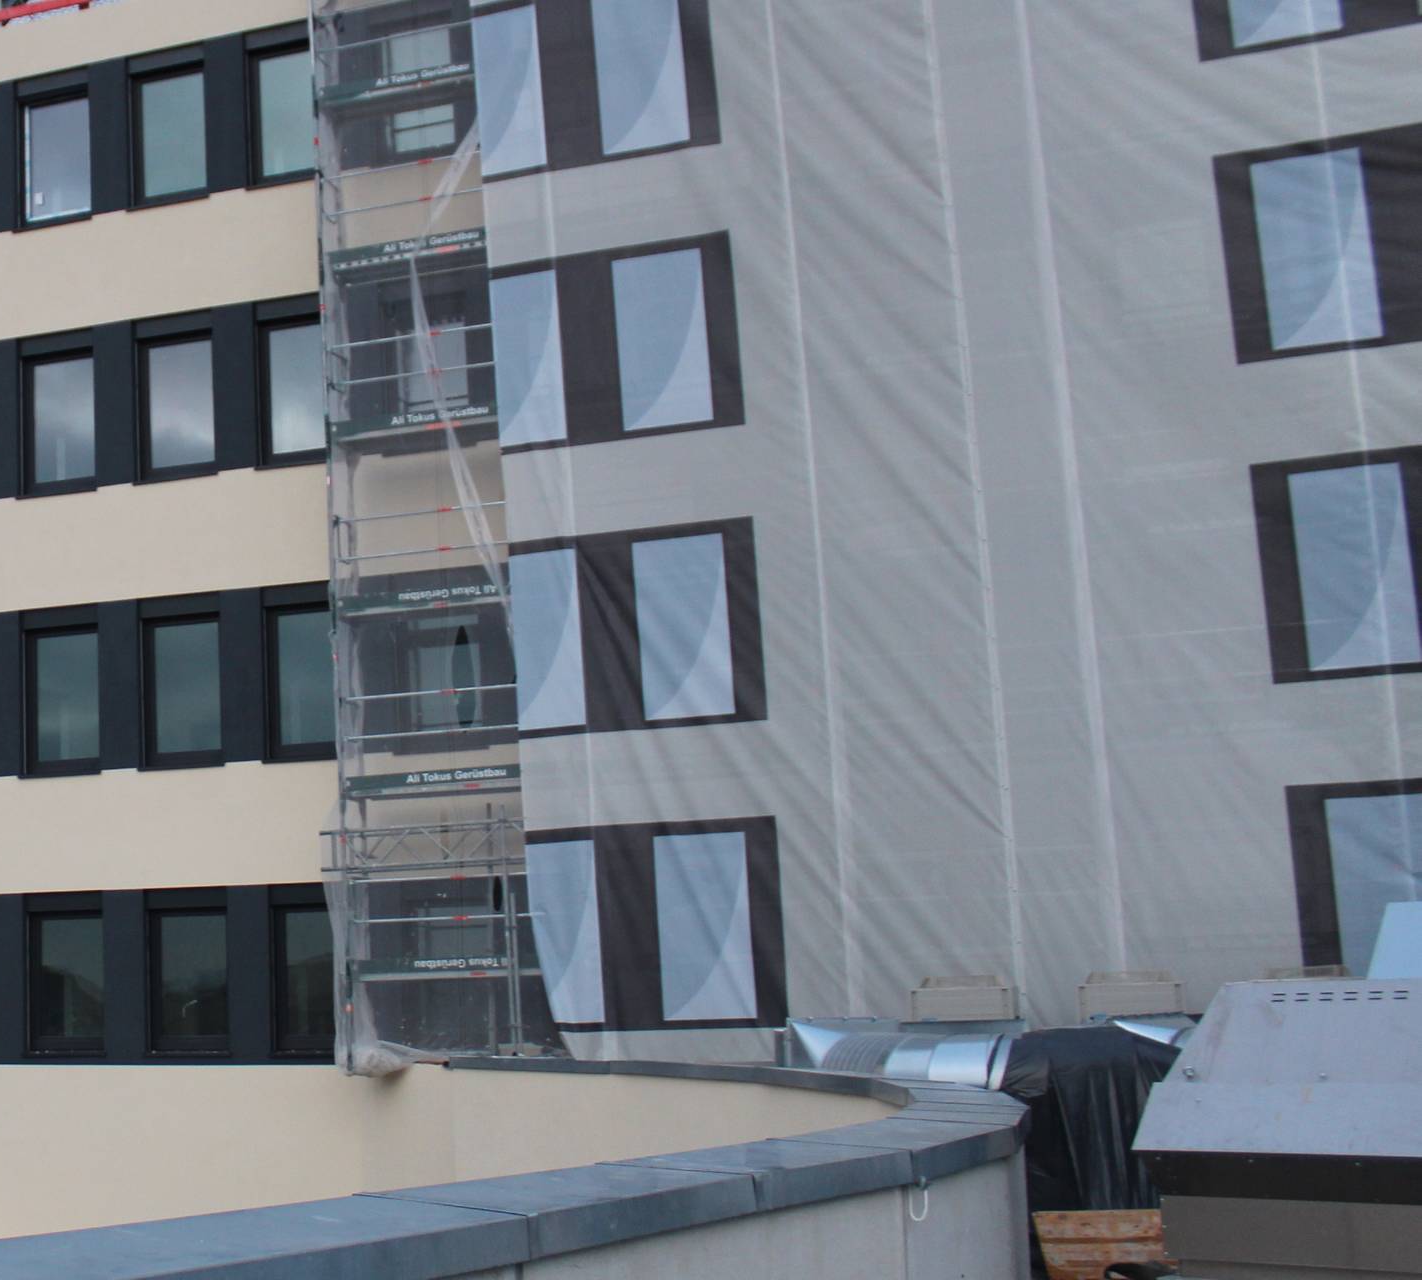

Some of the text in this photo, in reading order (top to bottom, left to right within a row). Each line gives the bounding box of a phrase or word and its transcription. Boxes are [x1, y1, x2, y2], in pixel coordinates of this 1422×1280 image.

[429, 231, 480, 246] Gerüstbau
[391, 416, 405, 424] Ali
[406, 412, 435, 423] Tokus
[398, 584, 497, 601] Ali Tokus Gerüstbau
[406, 767, 507, 783] Ali Tokus Gerüstbau
[414, 957, 467, 970] Gerüstbau
[469, 957, 499, 968] Tokus
